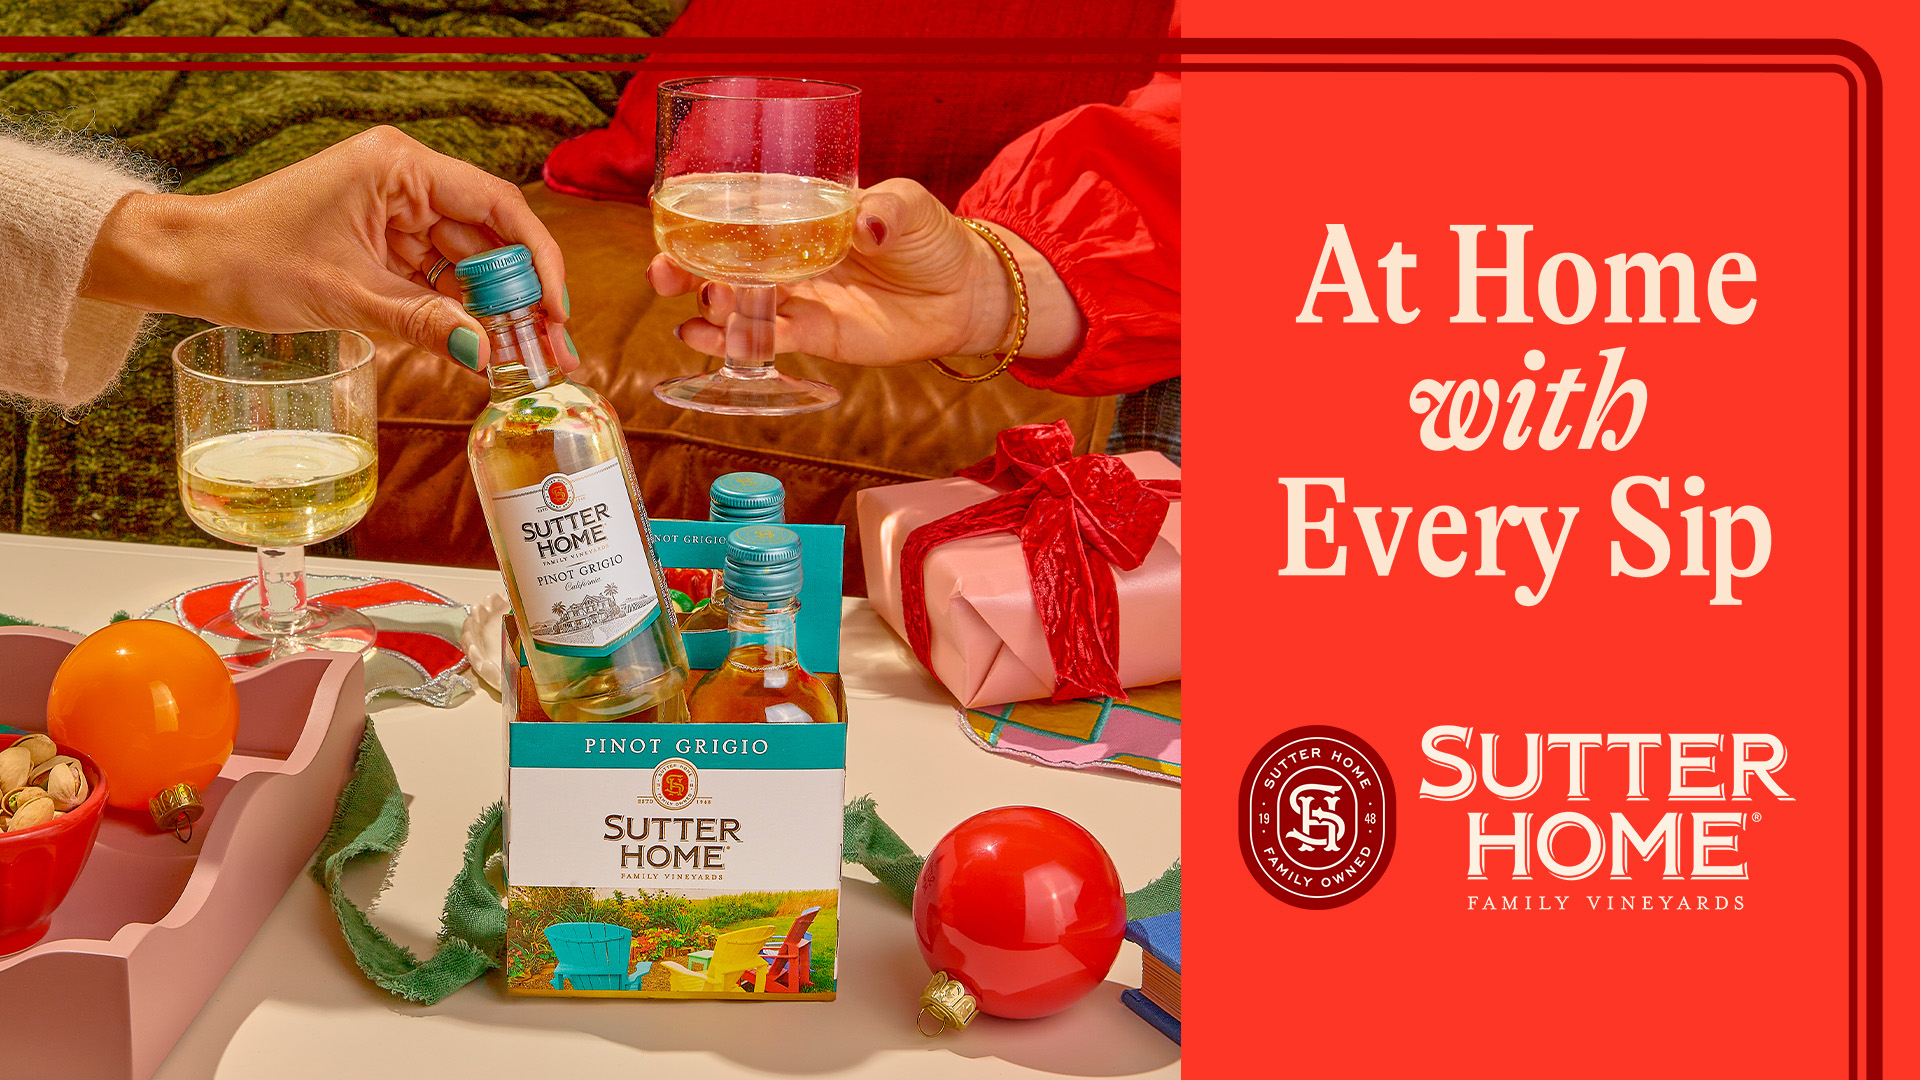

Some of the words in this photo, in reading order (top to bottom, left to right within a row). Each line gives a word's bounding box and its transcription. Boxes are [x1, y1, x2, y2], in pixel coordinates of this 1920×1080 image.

[521, 503, 612, 542] SUTTER
[537, 524, 609, 559] HOME
[654, 534, 679, 543] NOT
[683, 535, 727, 545] GRIGIO
[543, 556, 568, 567] FAMILY
[571, 544, 610, 559] VINEYARDS
[537, 570, 574, 587] PINOT
[579, 554, 623, 576] GRIGIO
[565, 577, 602, 592] California
[585, 738, 661, 754] PINOT
[675, 738, 769, 755] GRIGIO
[603, 814, 743, 843] SUTTER
[620, 844, 727, 870] HOME
[621, 872, 659, 880] FAMILY
[664, 873, 723, 881] VINEYARDS
